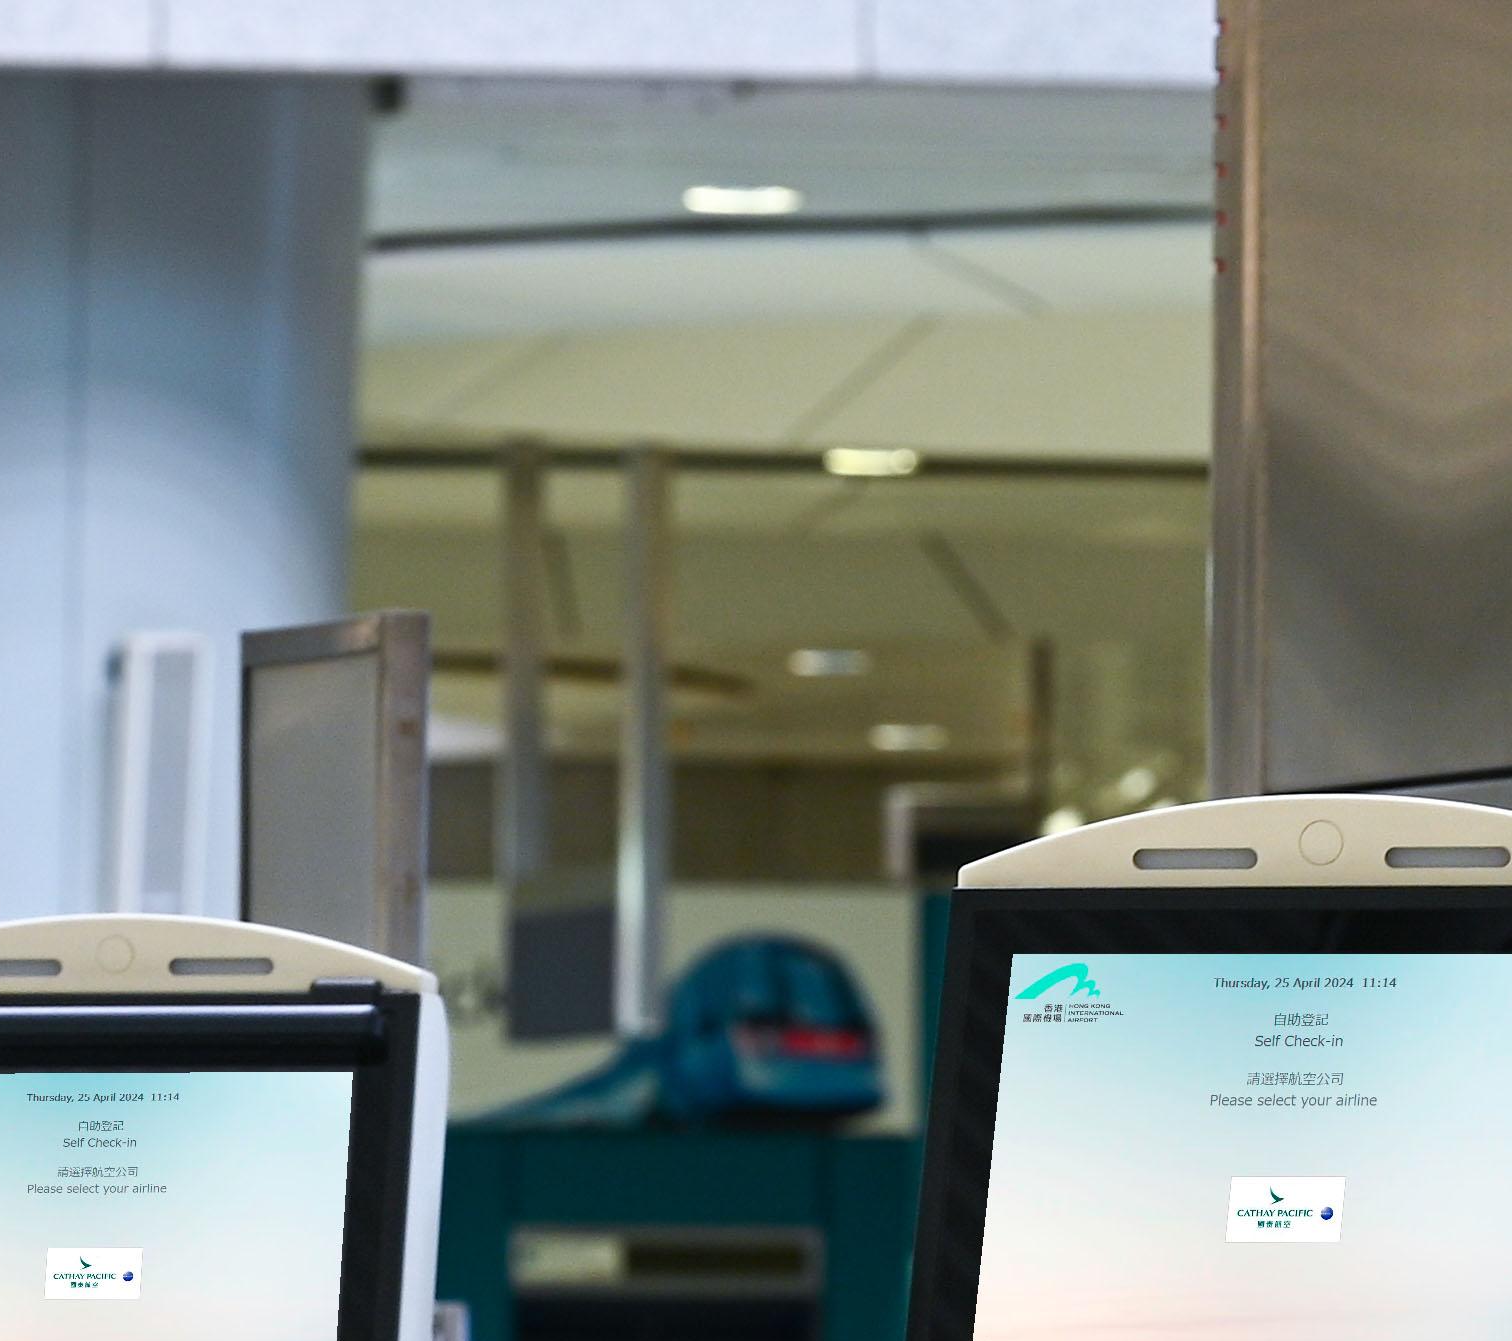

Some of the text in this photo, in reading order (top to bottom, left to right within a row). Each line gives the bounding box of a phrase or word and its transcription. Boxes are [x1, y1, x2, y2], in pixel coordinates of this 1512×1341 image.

[1213, 977, 1398, 991] Thursday, 25 April 2024 11:14
[1274, 1011, 1328, 1026] 自助登記
[1254, 1034, 1344, 1047] Self Check-in
[1247, 1072, 1343, 1086] 請選擇航空公司
[26, 1092, 180, 1104] Thursday, 25 April 2024 11:14
[1209, 1093, 1378, 1110] Please select your airline
[77, 1119, 125, 1132] 自助登記
[62, 1137, 137, 1148] Self Check-in
[27, 1183, 168, 1196] Please select your airline
[1236, 1209, 1313, 1217] CATHAY PACIFIC
